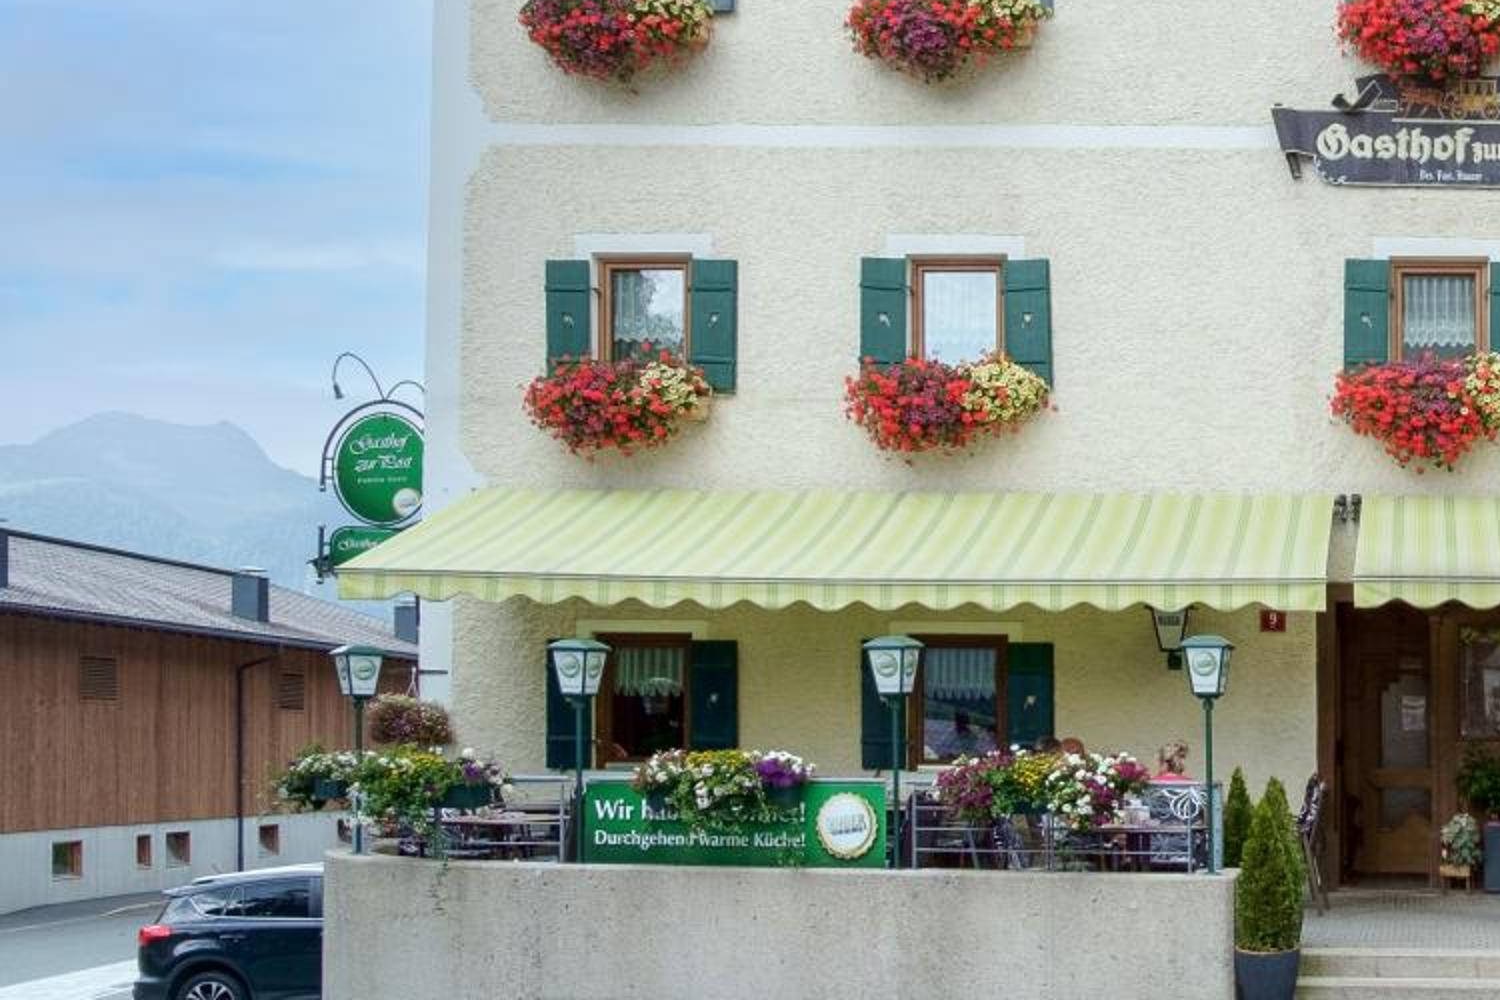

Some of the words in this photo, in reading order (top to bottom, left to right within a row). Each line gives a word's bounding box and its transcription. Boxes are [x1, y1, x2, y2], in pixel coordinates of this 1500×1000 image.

[1316, 123, 1474, 164] Gasthof
[350, 432, 412, 455] Gasthof
[594, 798, 635, 821] Wir
